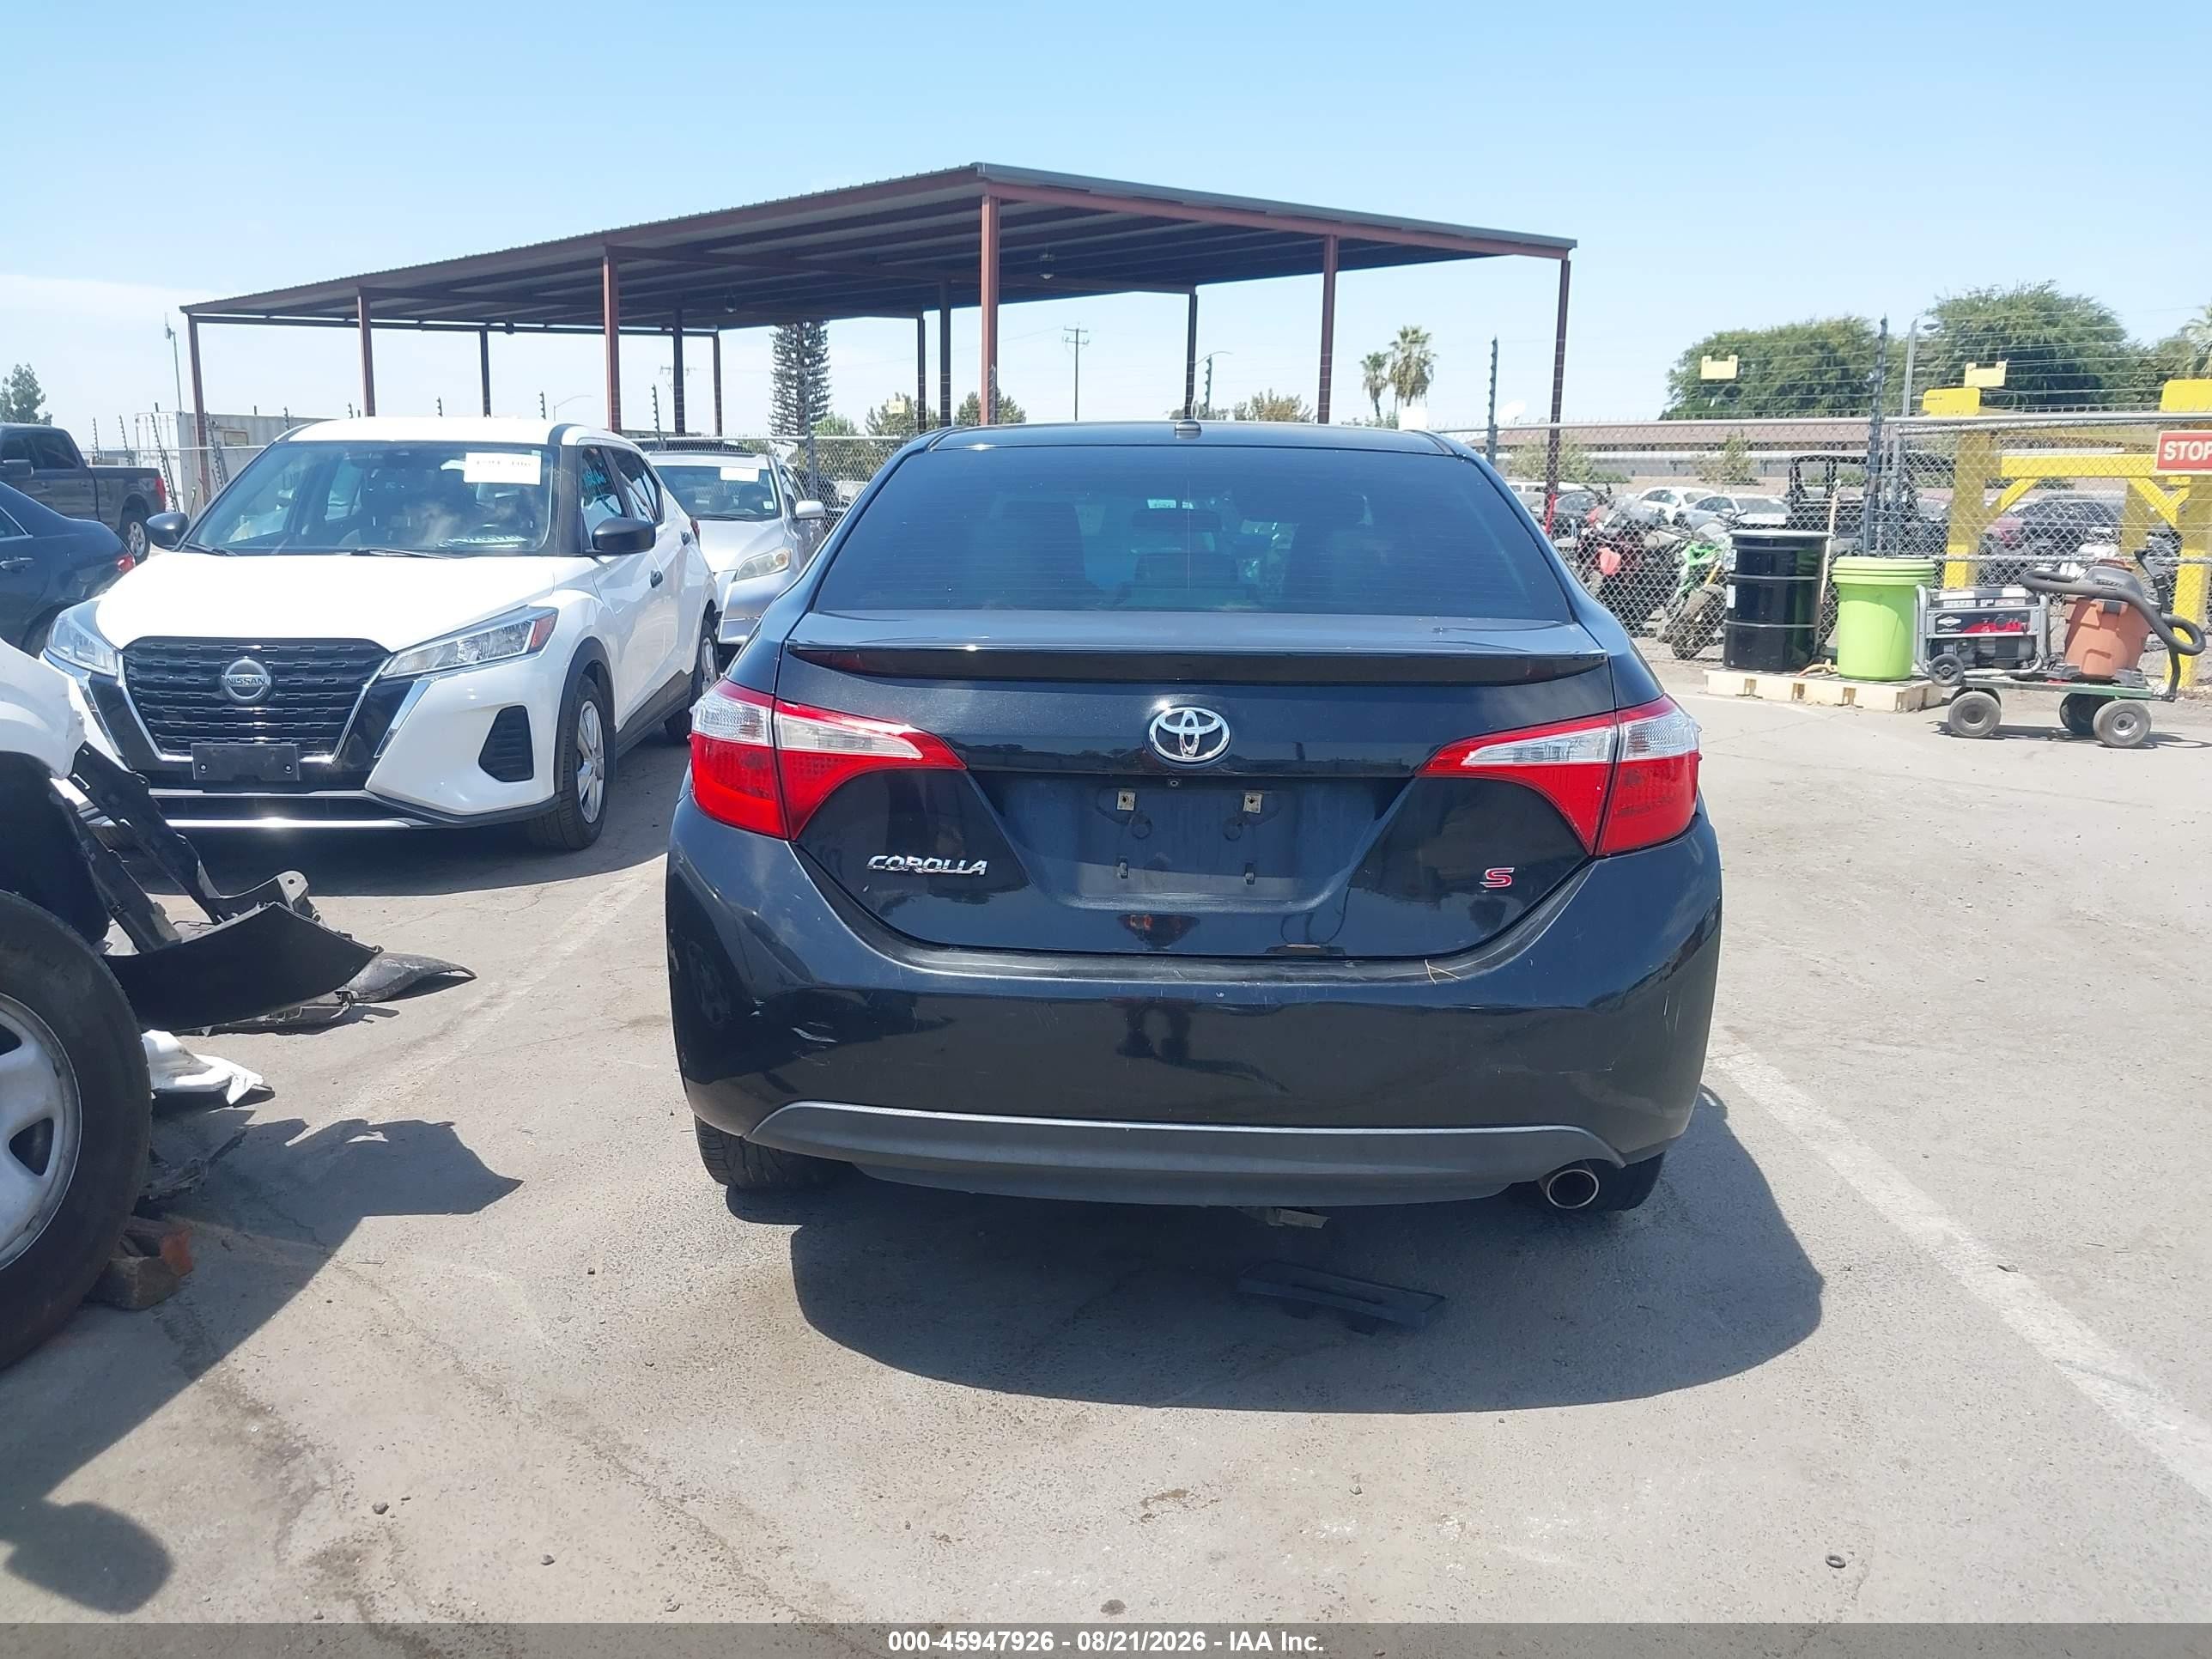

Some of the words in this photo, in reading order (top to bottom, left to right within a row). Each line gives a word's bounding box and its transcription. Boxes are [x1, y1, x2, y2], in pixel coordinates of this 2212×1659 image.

[2164, 440, 2212, 461] STOP
[866, 855, 988, 876] COROLLA
[1479, 867, 1515, 888] S
